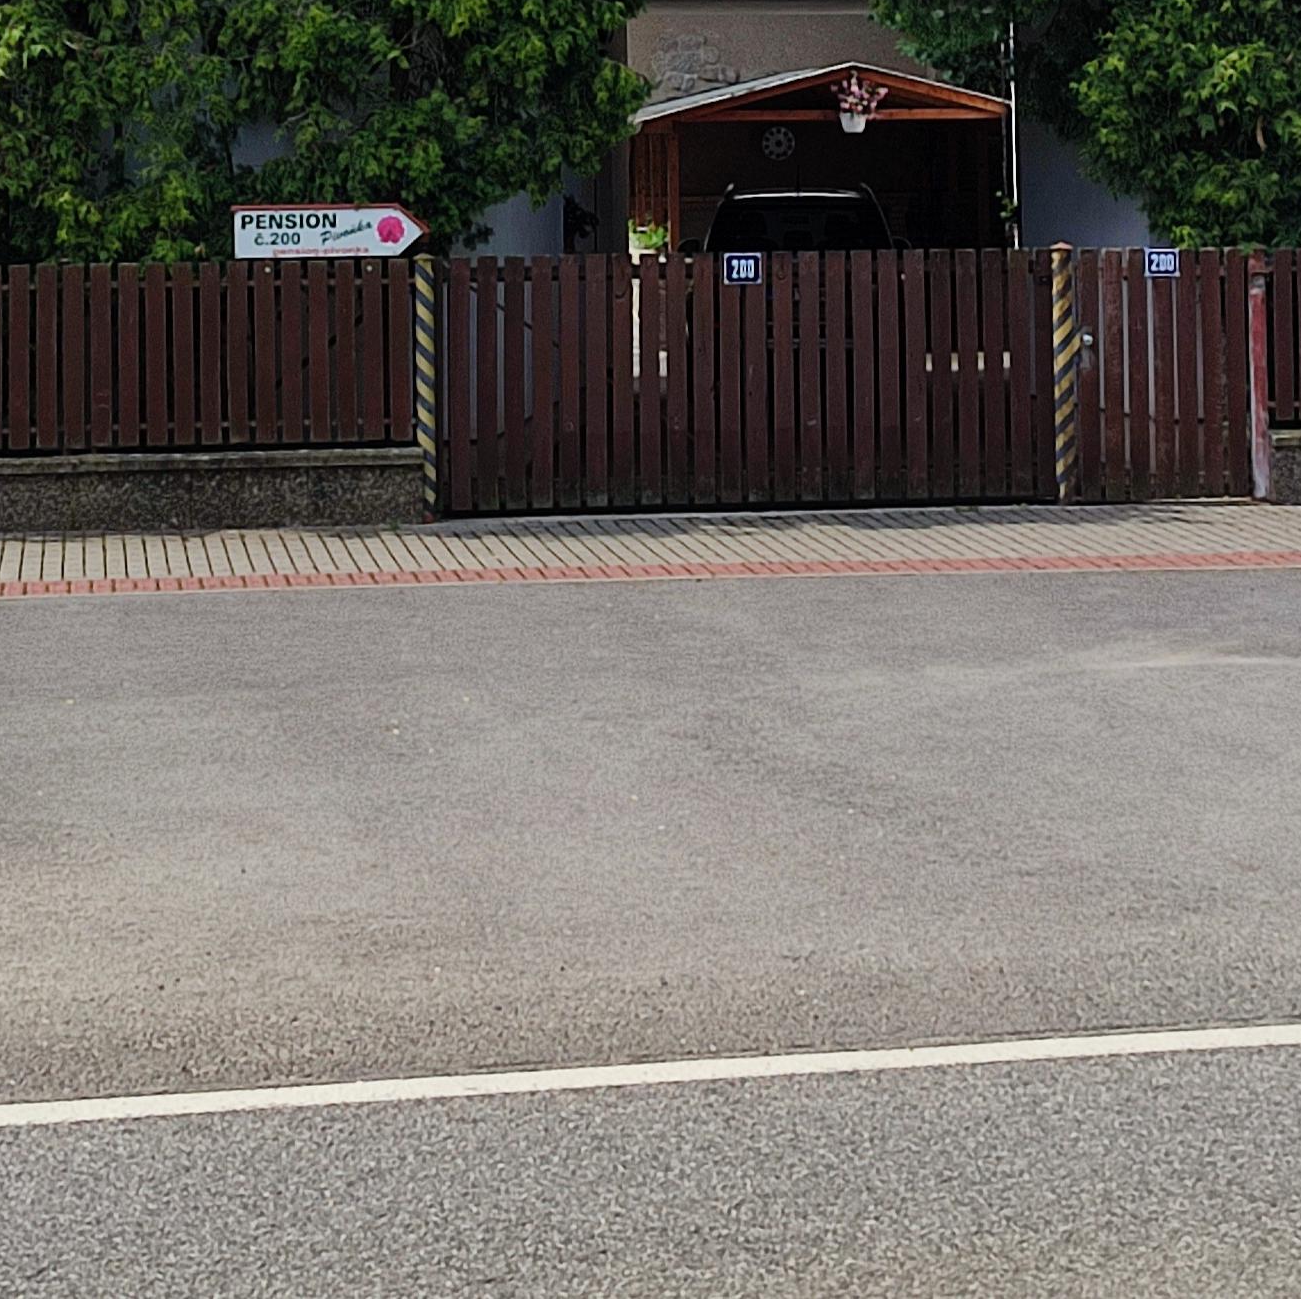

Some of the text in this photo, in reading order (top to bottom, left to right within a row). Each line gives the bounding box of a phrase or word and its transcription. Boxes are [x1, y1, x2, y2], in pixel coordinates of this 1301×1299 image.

[241, 212, 337, 230] PENSION
[254, 231, 301, 246] č.200
[731, 259, 755, 279] 200
[1150, 253, 1175, 272] 200
